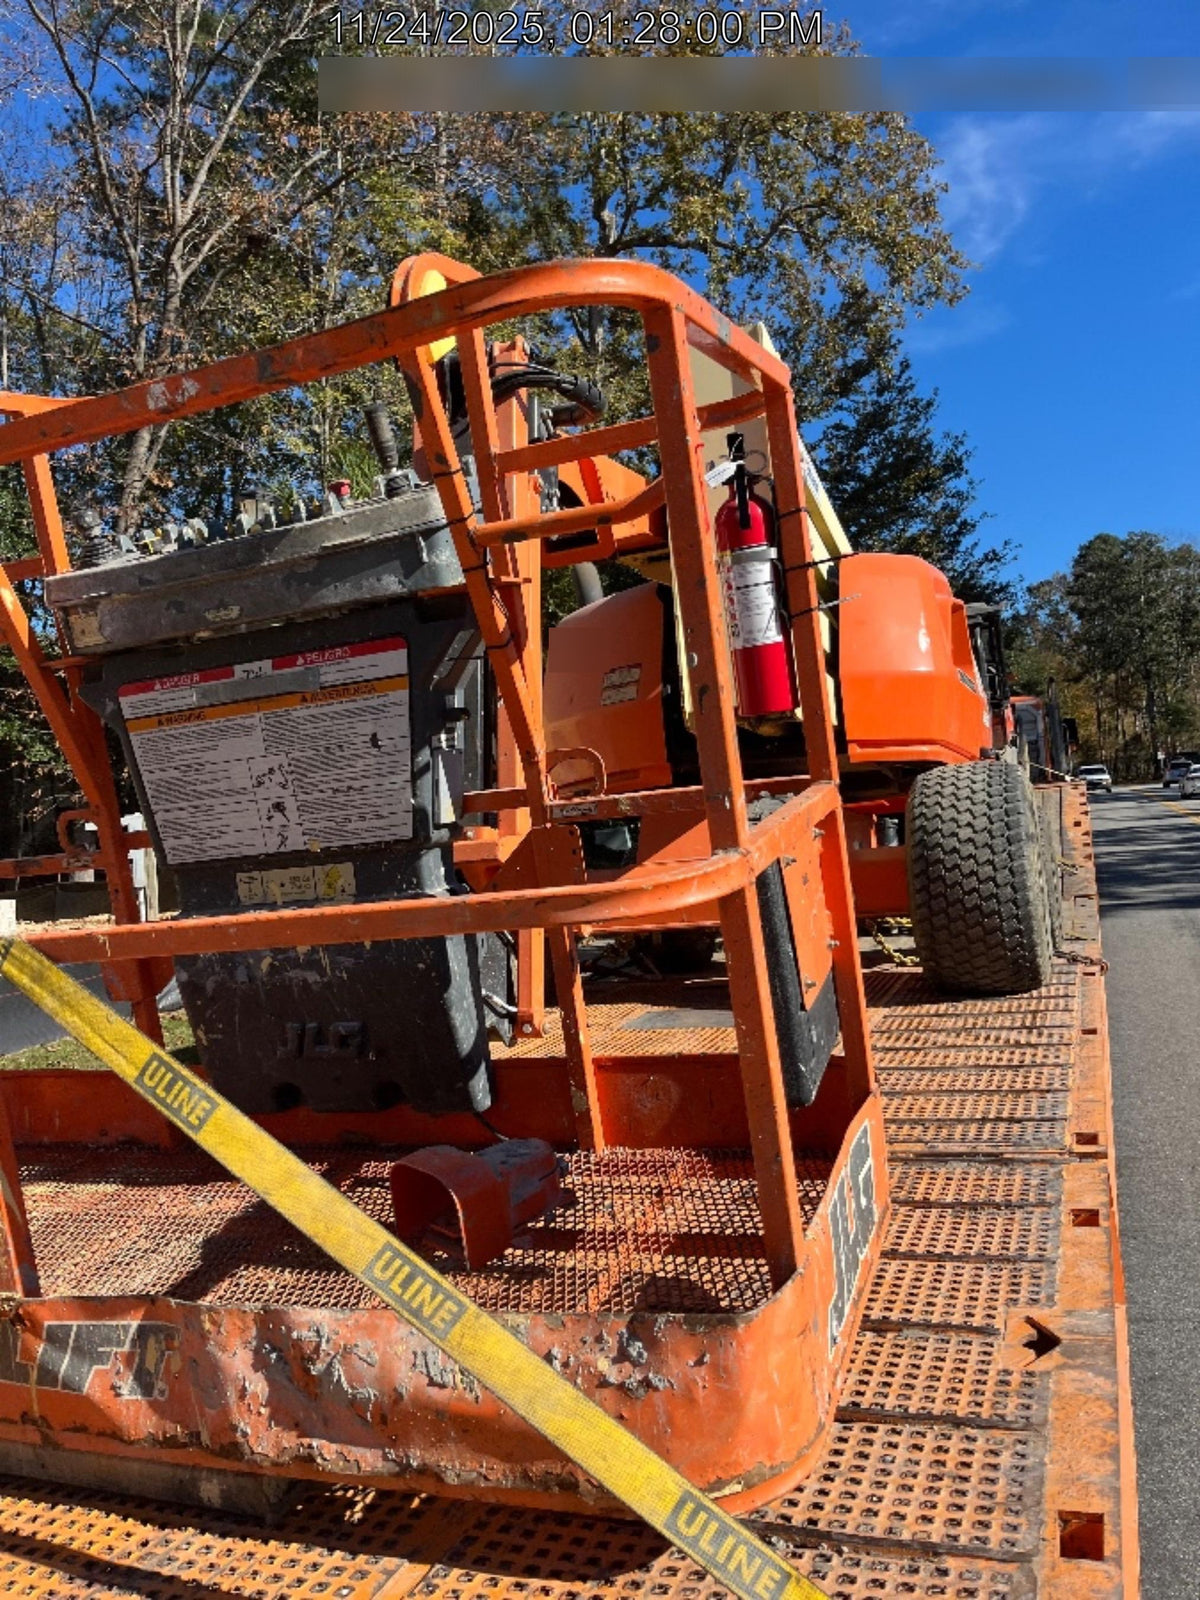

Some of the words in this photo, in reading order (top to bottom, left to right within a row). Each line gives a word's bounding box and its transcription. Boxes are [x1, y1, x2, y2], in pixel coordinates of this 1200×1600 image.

[142, 1060, 212, 1126] ULINE
[372, 1250, 459, 1330] ULINE
[676, 1500, 782, 1600] ULINE
